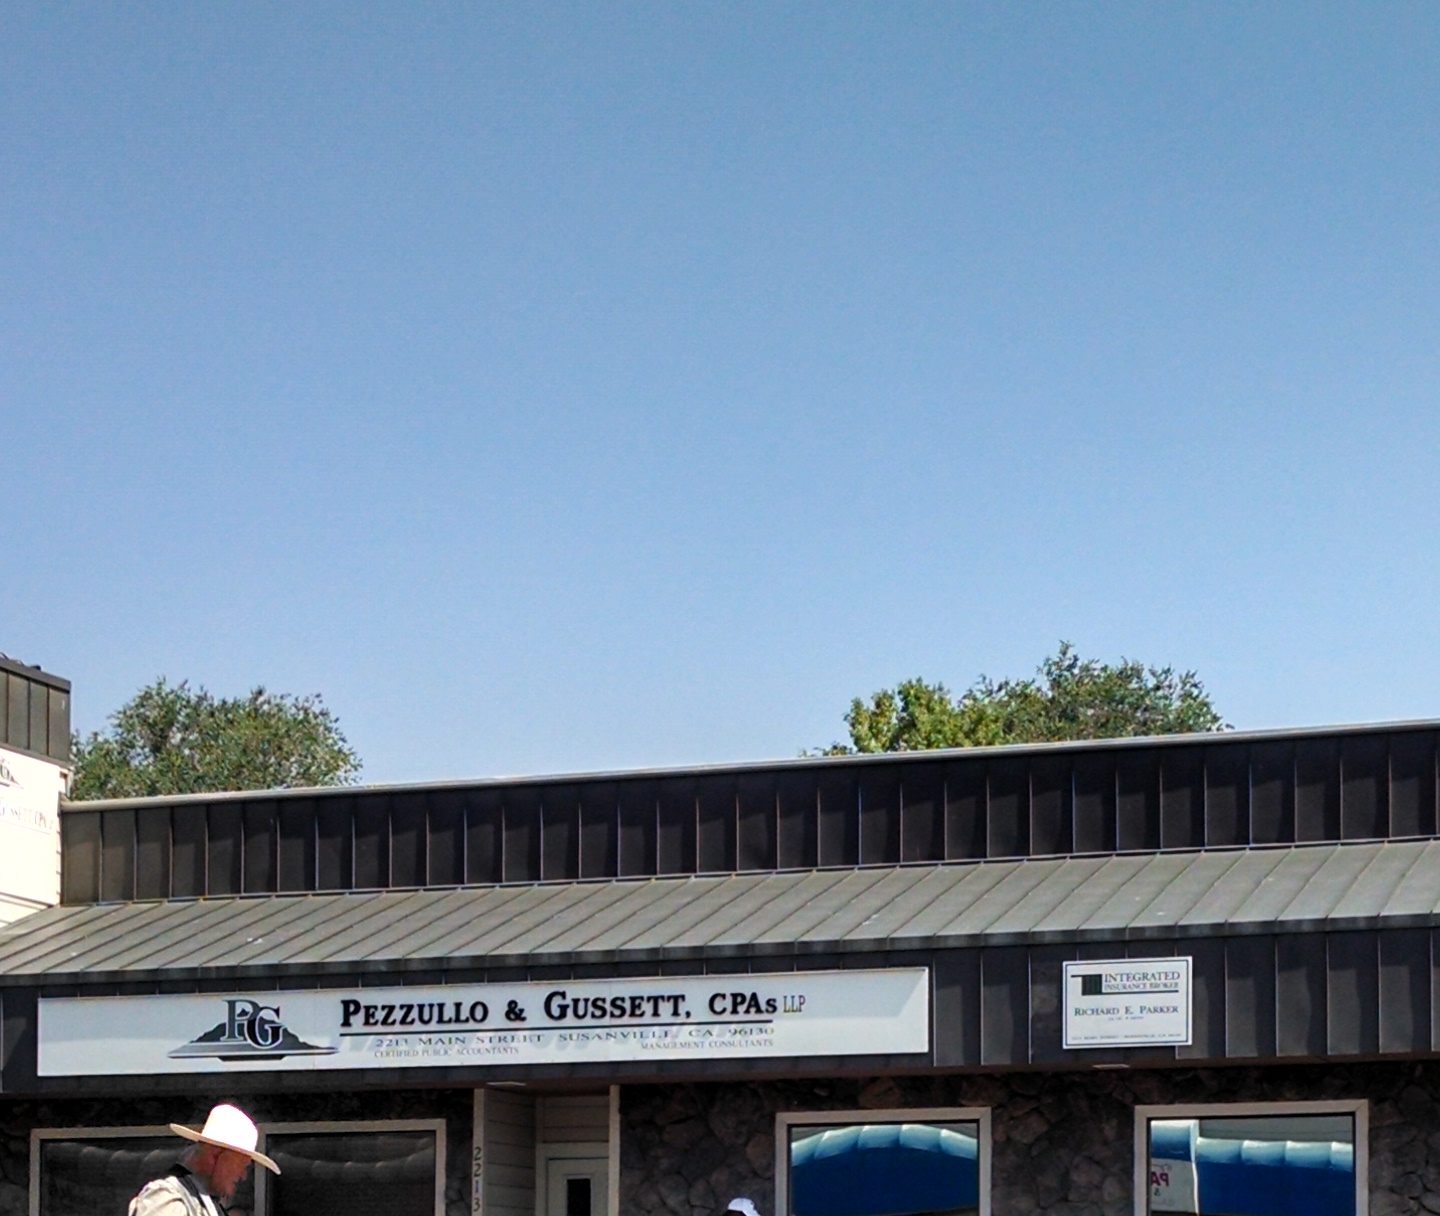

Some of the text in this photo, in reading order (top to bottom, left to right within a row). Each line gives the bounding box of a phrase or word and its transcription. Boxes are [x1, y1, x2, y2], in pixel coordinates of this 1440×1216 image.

[1104, 971, 1181, 983] INTEGRATED
[1104, 983, 1147, 991] INSURANCE
[340, 999, 489, 1027] PEZZULLO
[505, 1000, 527, 1022] &
[544, 990, 692, 1021] GUSSETT,
[783, 995, 806, 1013] LLP
[1074, 1005, 1179, 1017] RICHARD E. PARKER
[375, 1038, 409, 1048] 2213
[418, 1036, 466, 1046] MAIN
[476, 1034, 545, 1045] STREET
[728, 1026, 775, 1037] 96130
[374, 1038, 774, 1059] CERTIFIED PUBLIC ACCOUNTANTS MANAGEMENT CONSULTANTS
[473, 1147, 482, 1212] 2213
